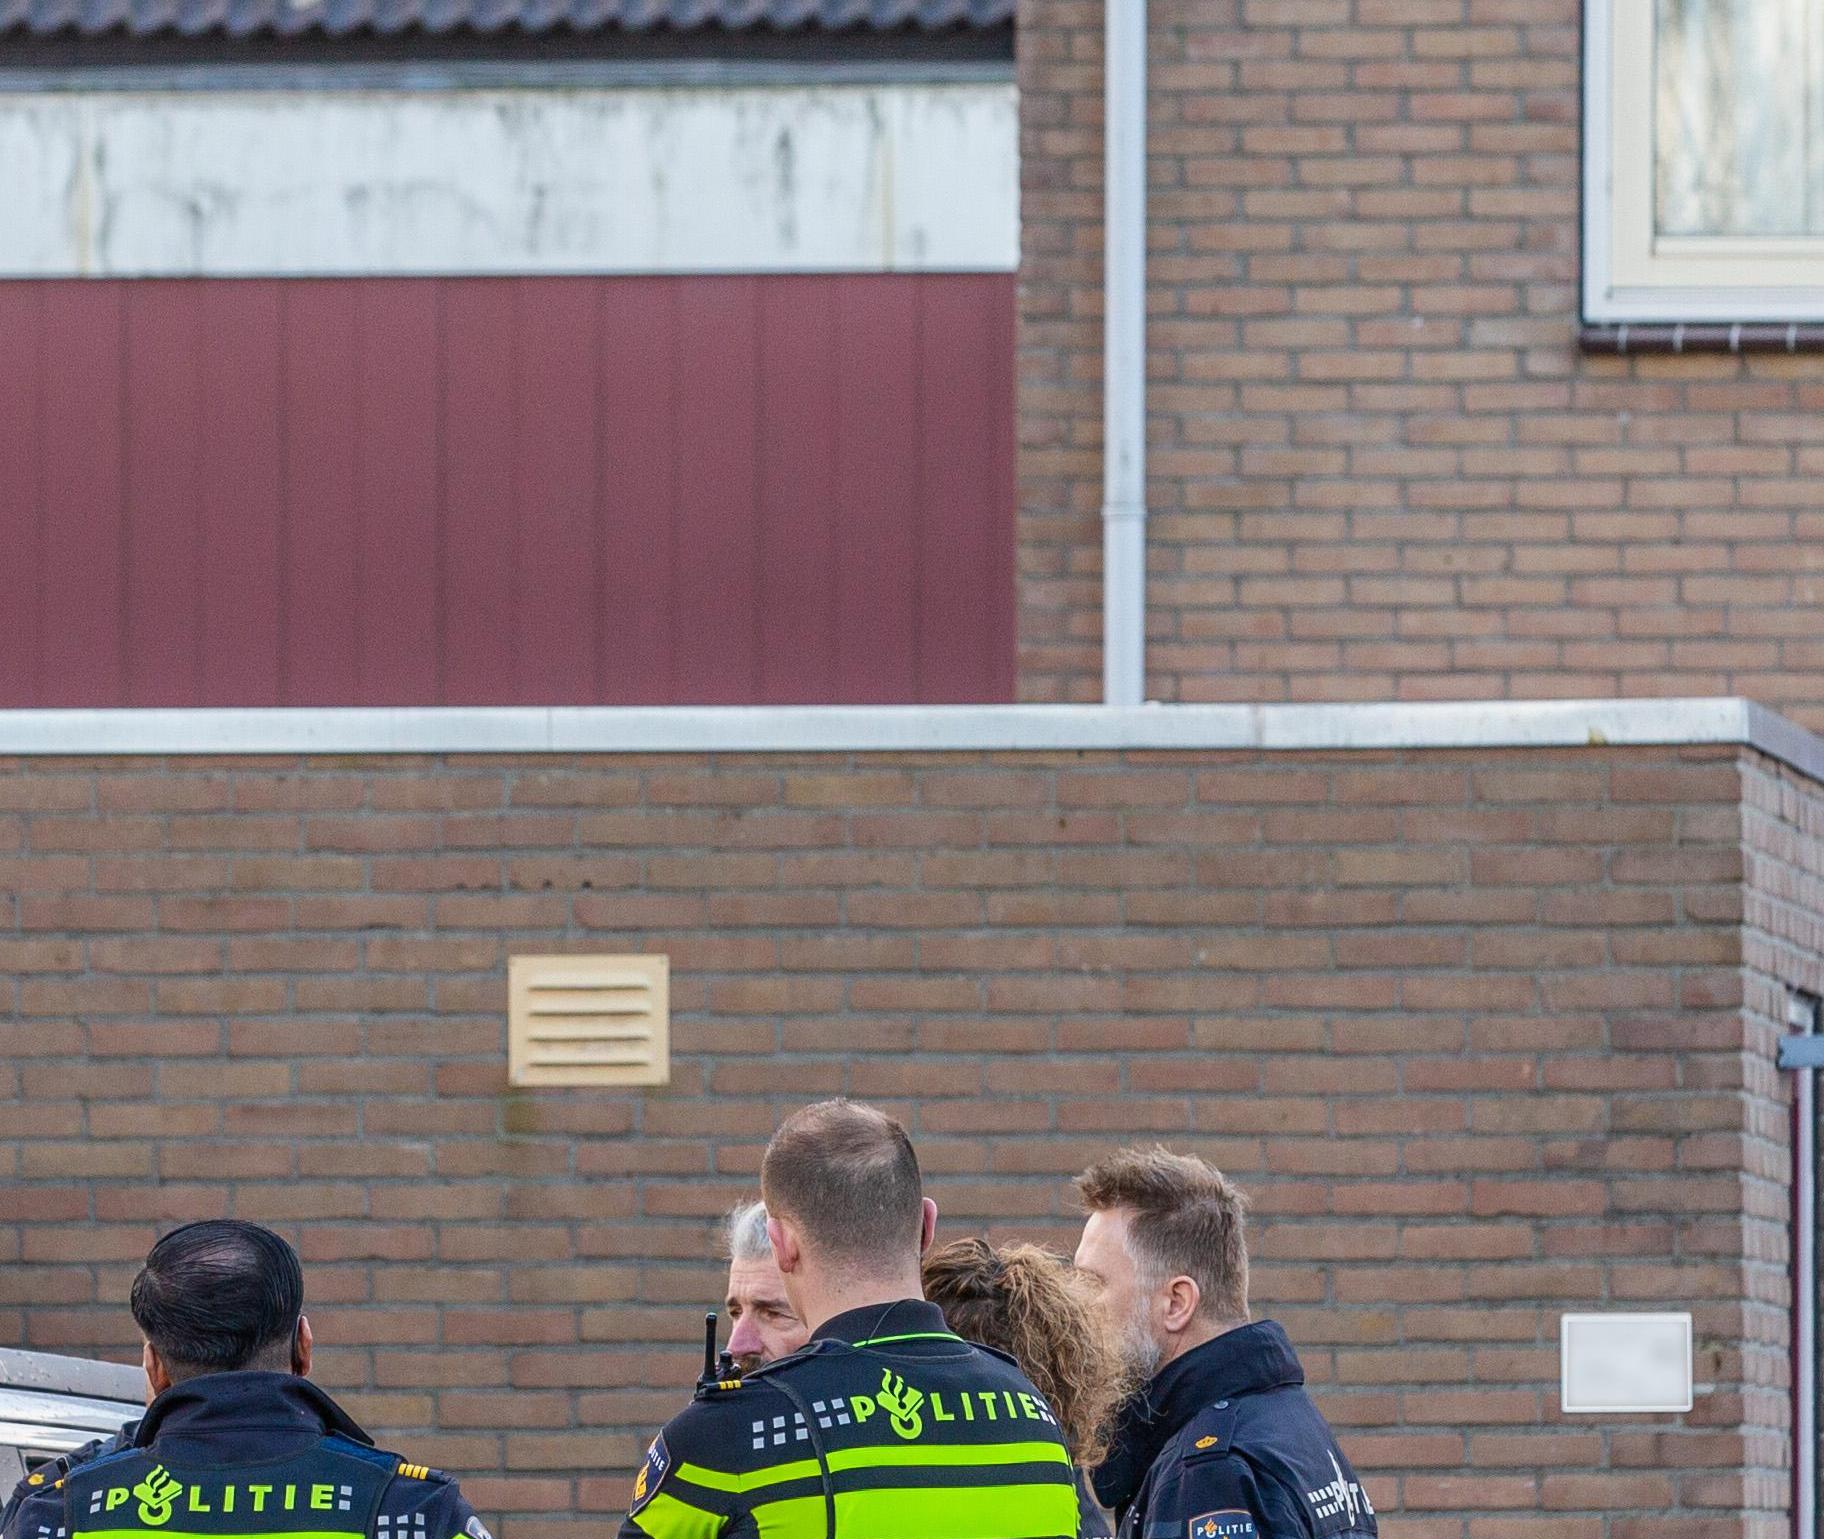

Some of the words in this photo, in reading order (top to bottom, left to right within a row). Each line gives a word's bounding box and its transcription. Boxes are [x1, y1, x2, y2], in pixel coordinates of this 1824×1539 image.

[850, 1386, 1041, 1440] POLITIE
[106, 1475, 334, 1526] POLITIE
[1197, 1521, 1253, 1538] POLITIE
